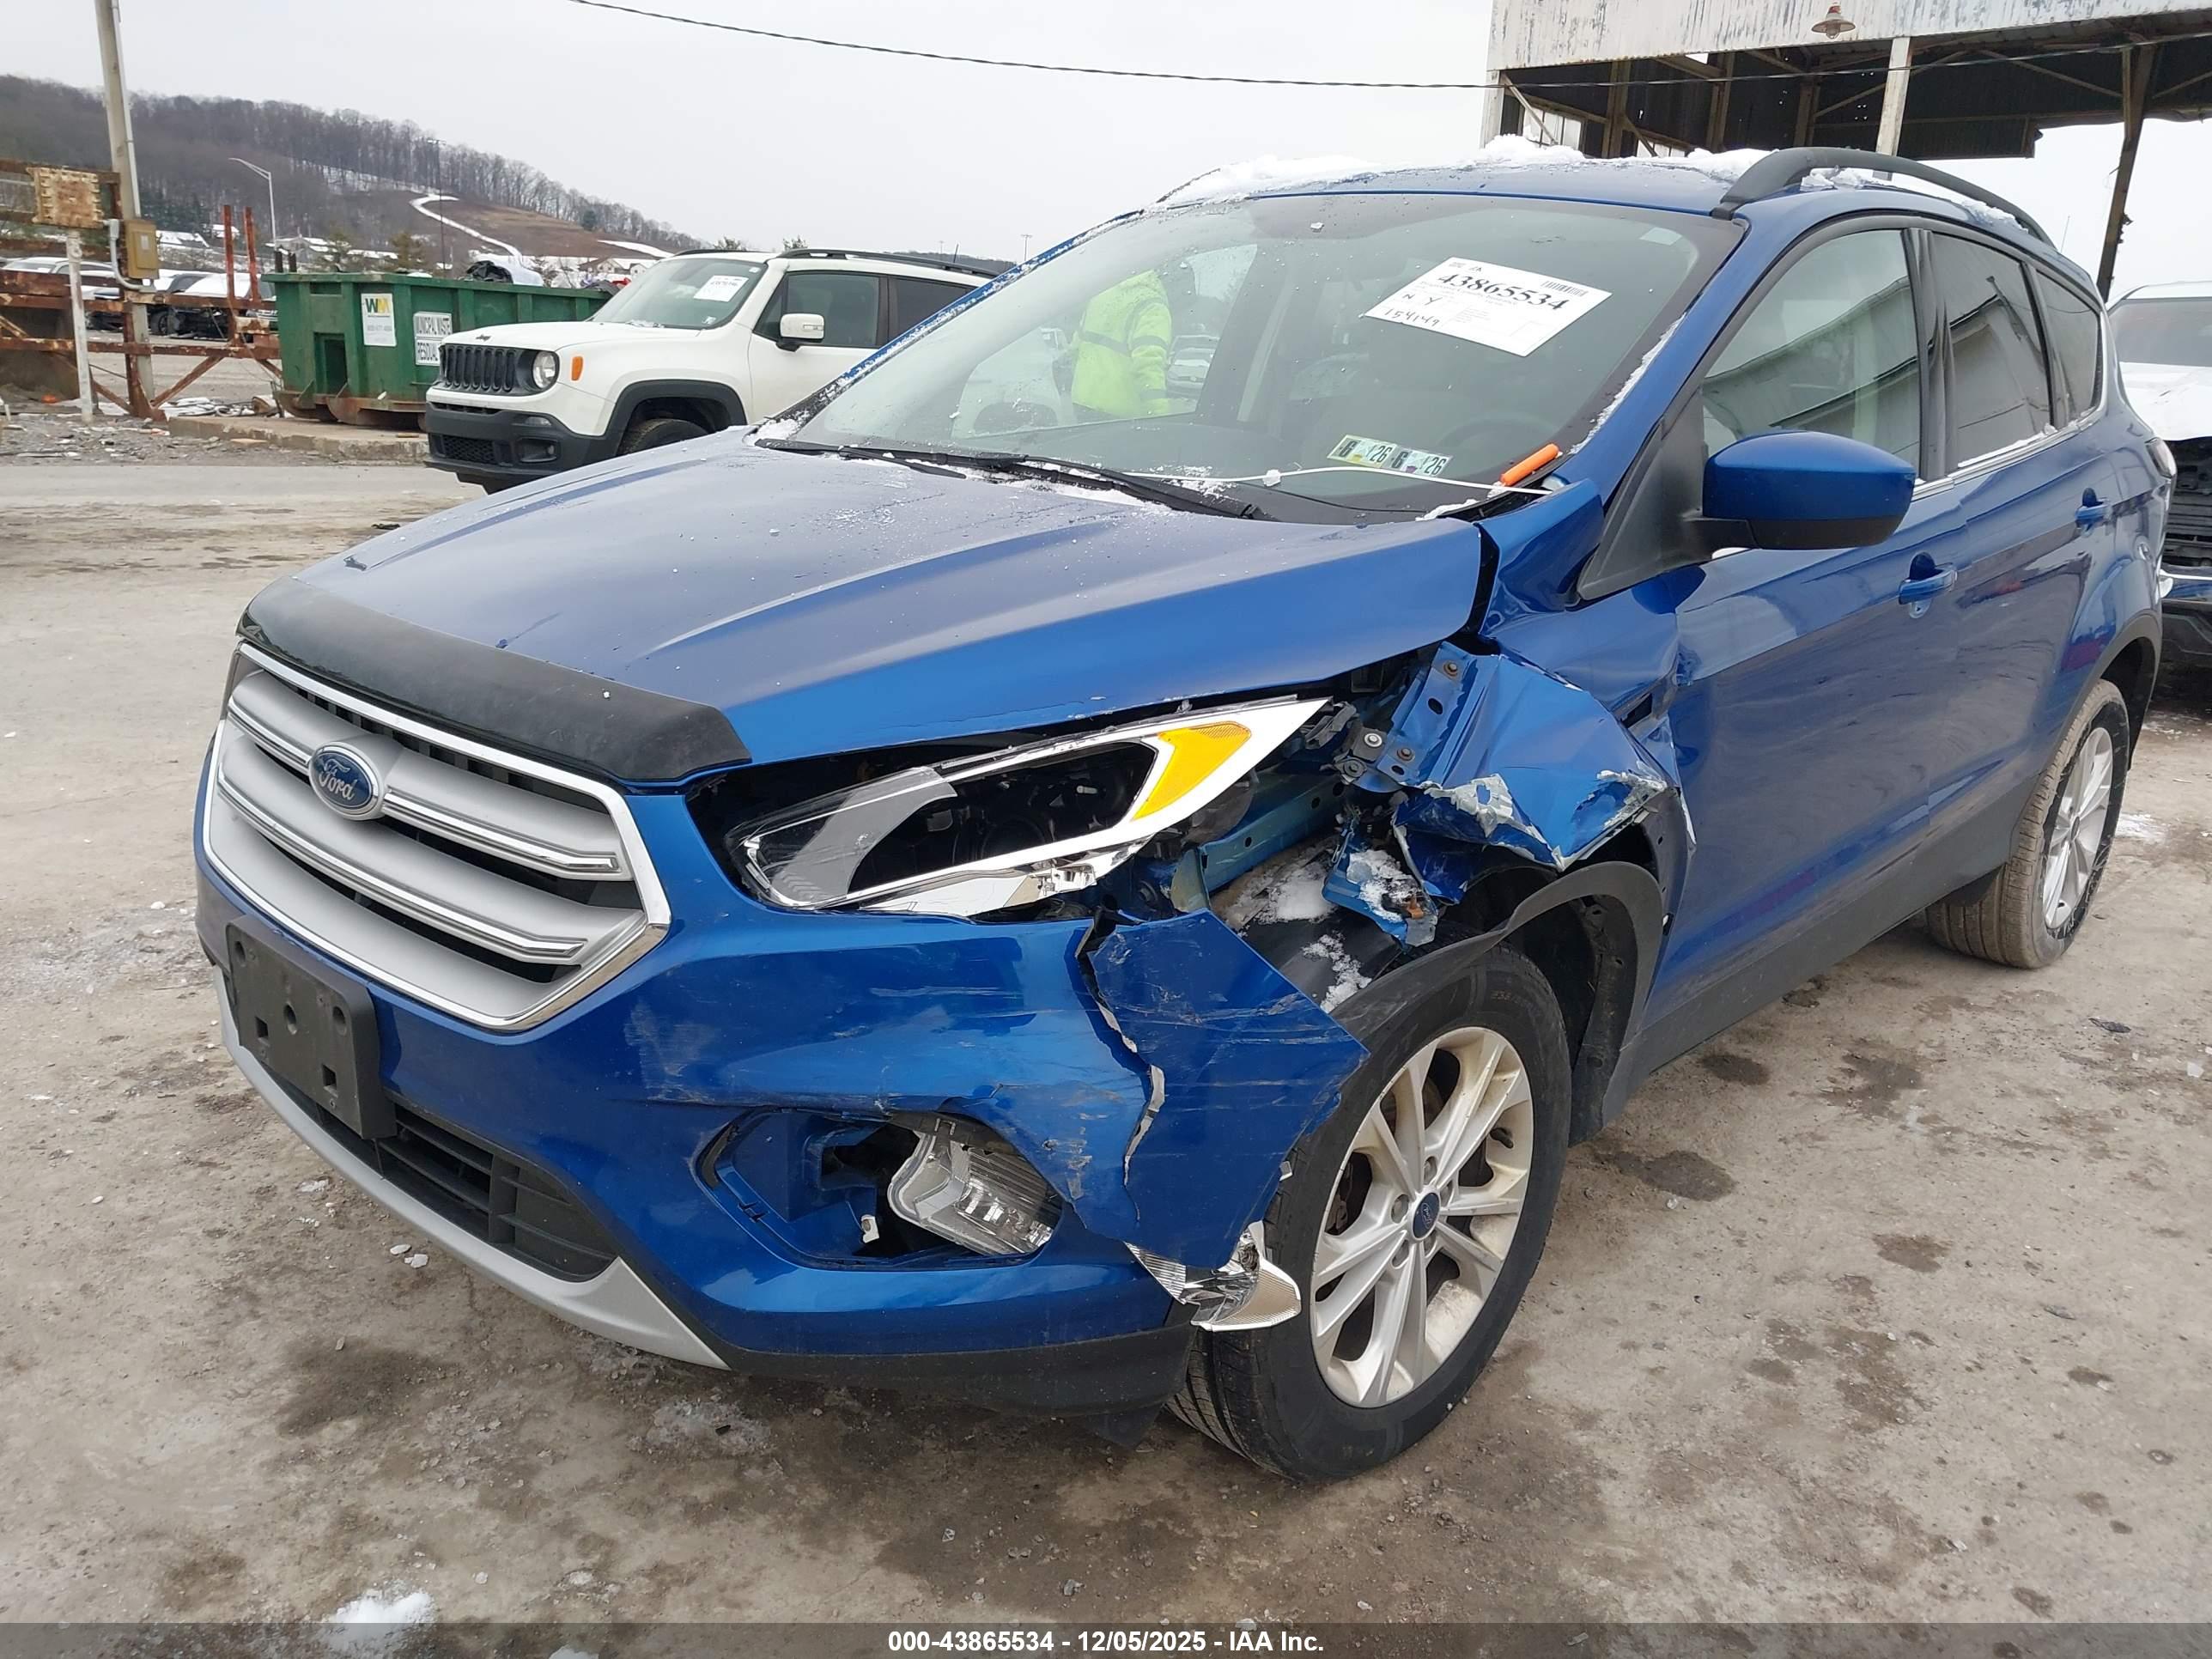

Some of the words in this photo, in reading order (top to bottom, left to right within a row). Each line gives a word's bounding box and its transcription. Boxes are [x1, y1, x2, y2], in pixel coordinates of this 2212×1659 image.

[365, 298, 391, 314] WM
[1437, 274, 1570, 310] 43865534
[319, 758, 357, 800] Ford
